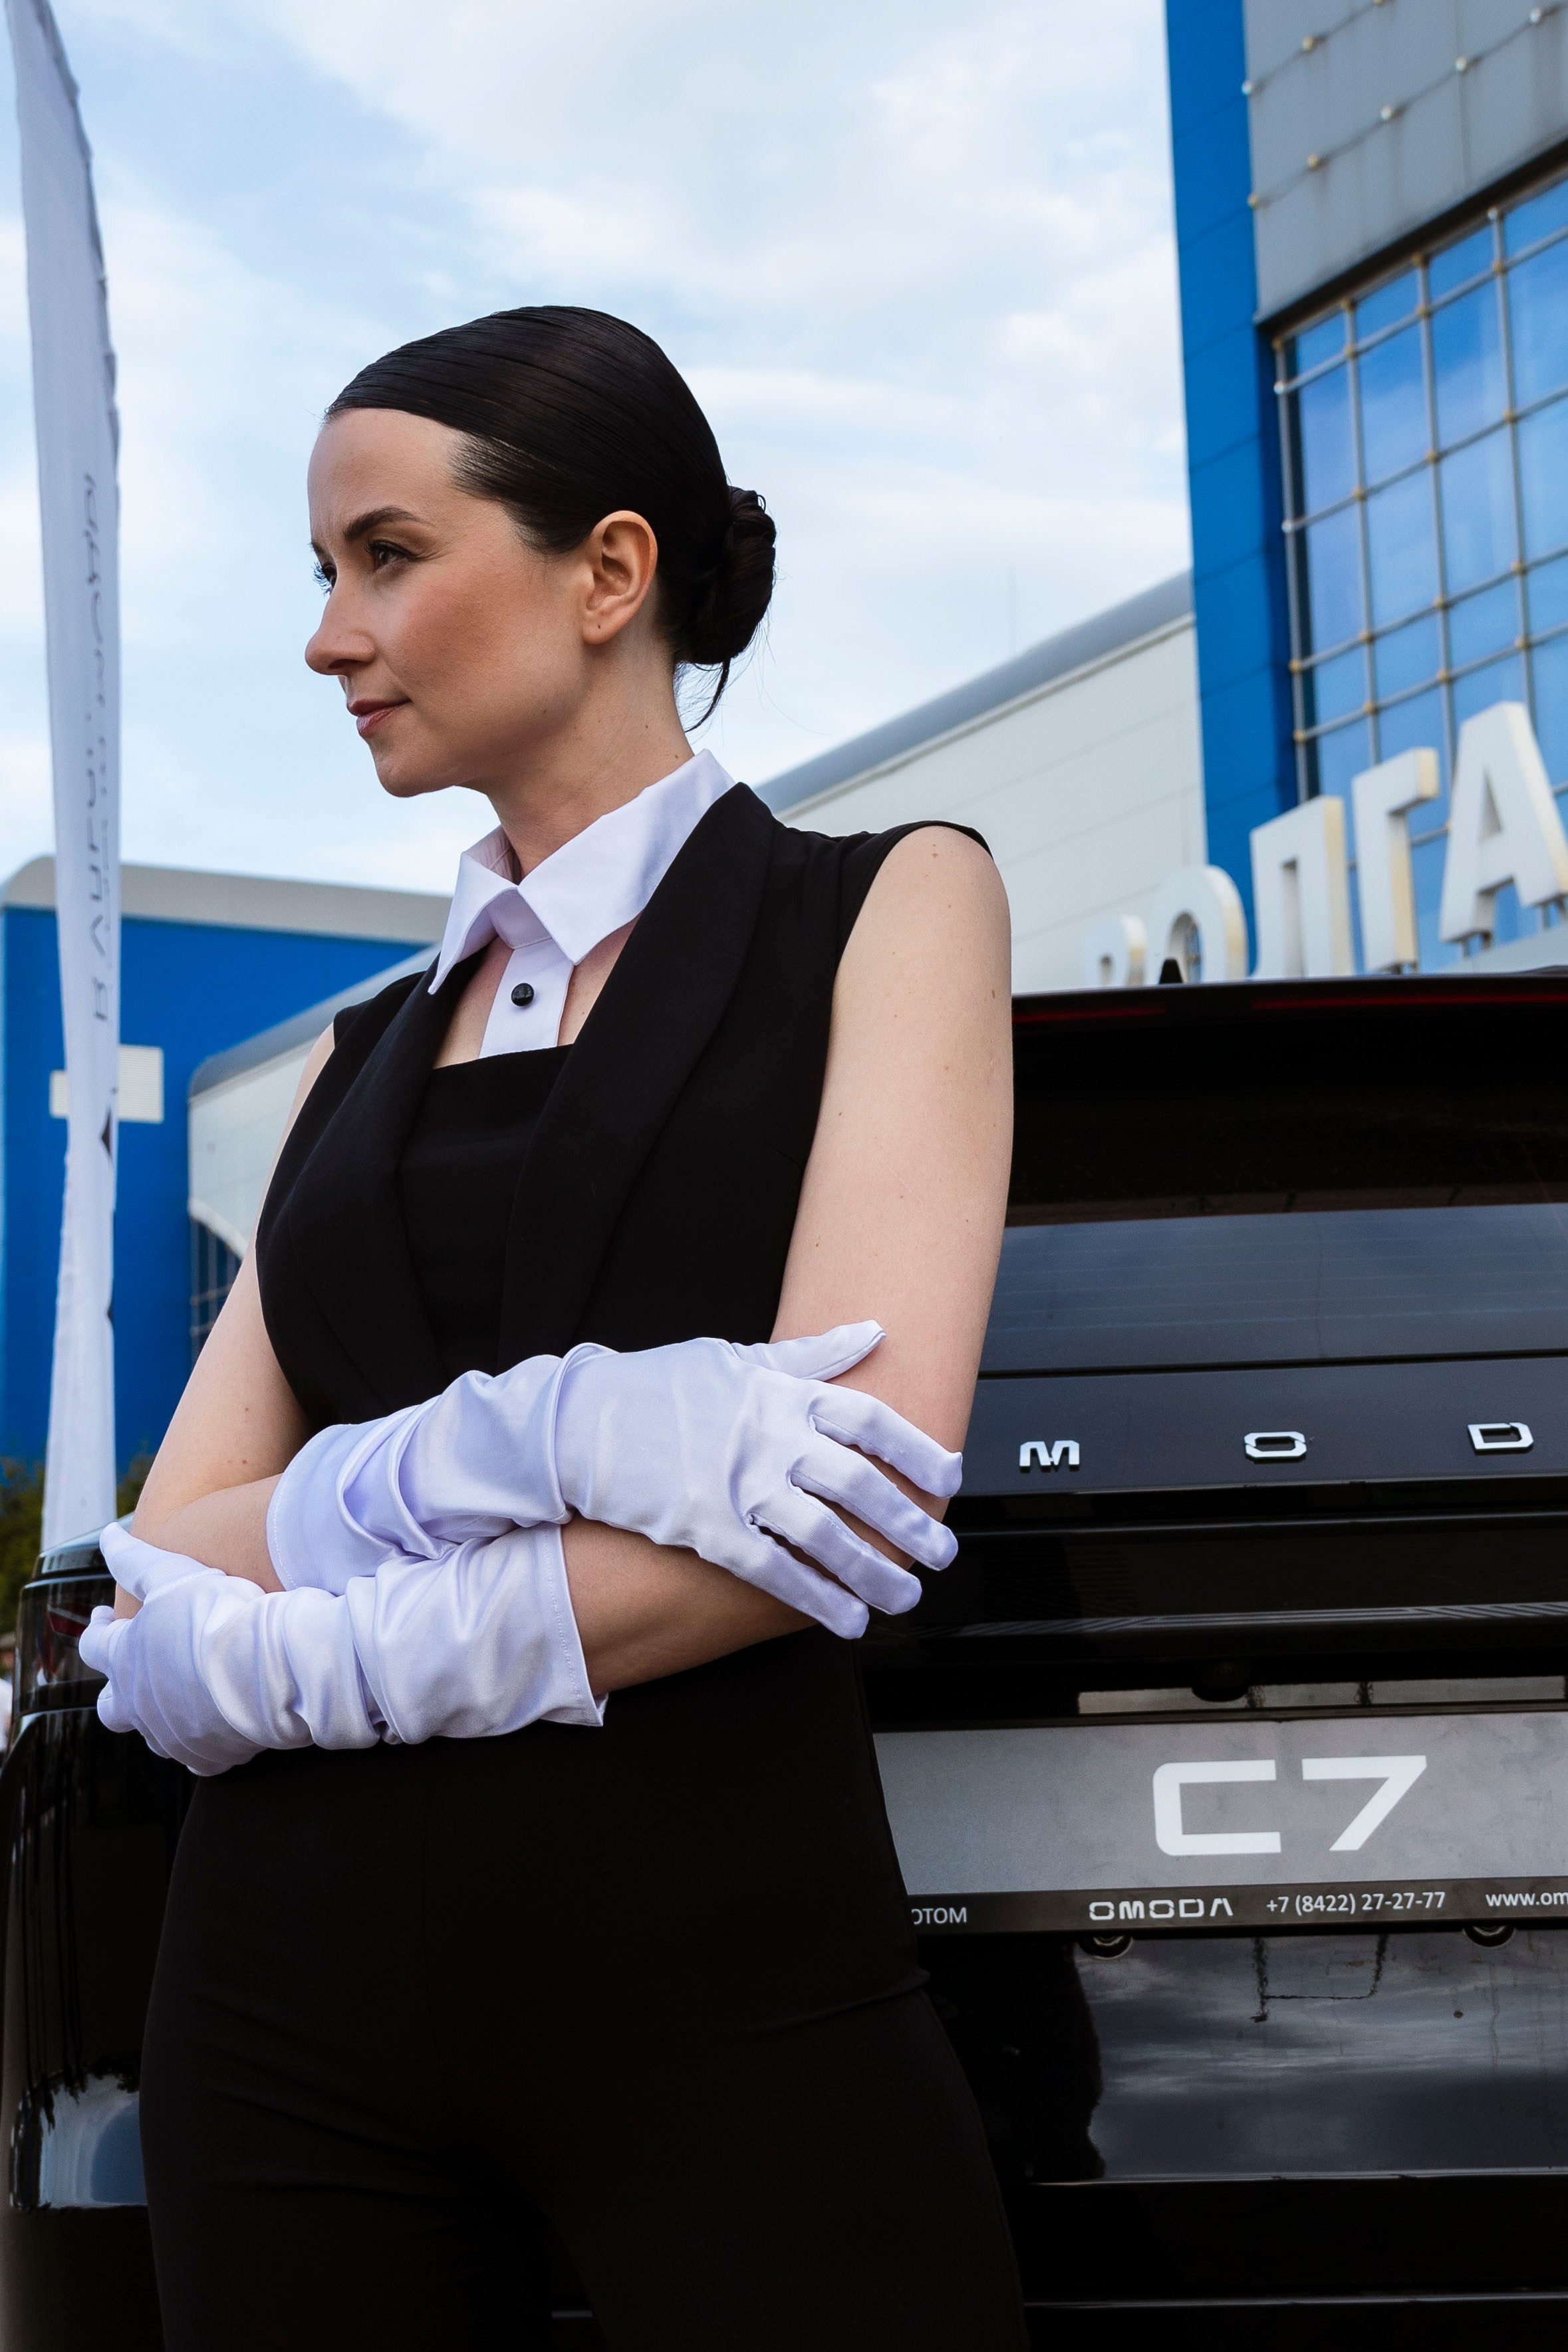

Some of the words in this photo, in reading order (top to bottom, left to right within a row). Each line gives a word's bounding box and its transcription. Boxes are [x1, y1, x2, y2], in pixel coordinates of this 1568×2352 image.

[1153, 1755, 1427, 1856] C7
[1089, 1898, 1234, 1920] OMODA
[1266, 1896, 1289, 1913] +7
[1295, 1893, 1357, 1916] (8422)
[1361, 1891, 1446, 1911] 27-27-77
